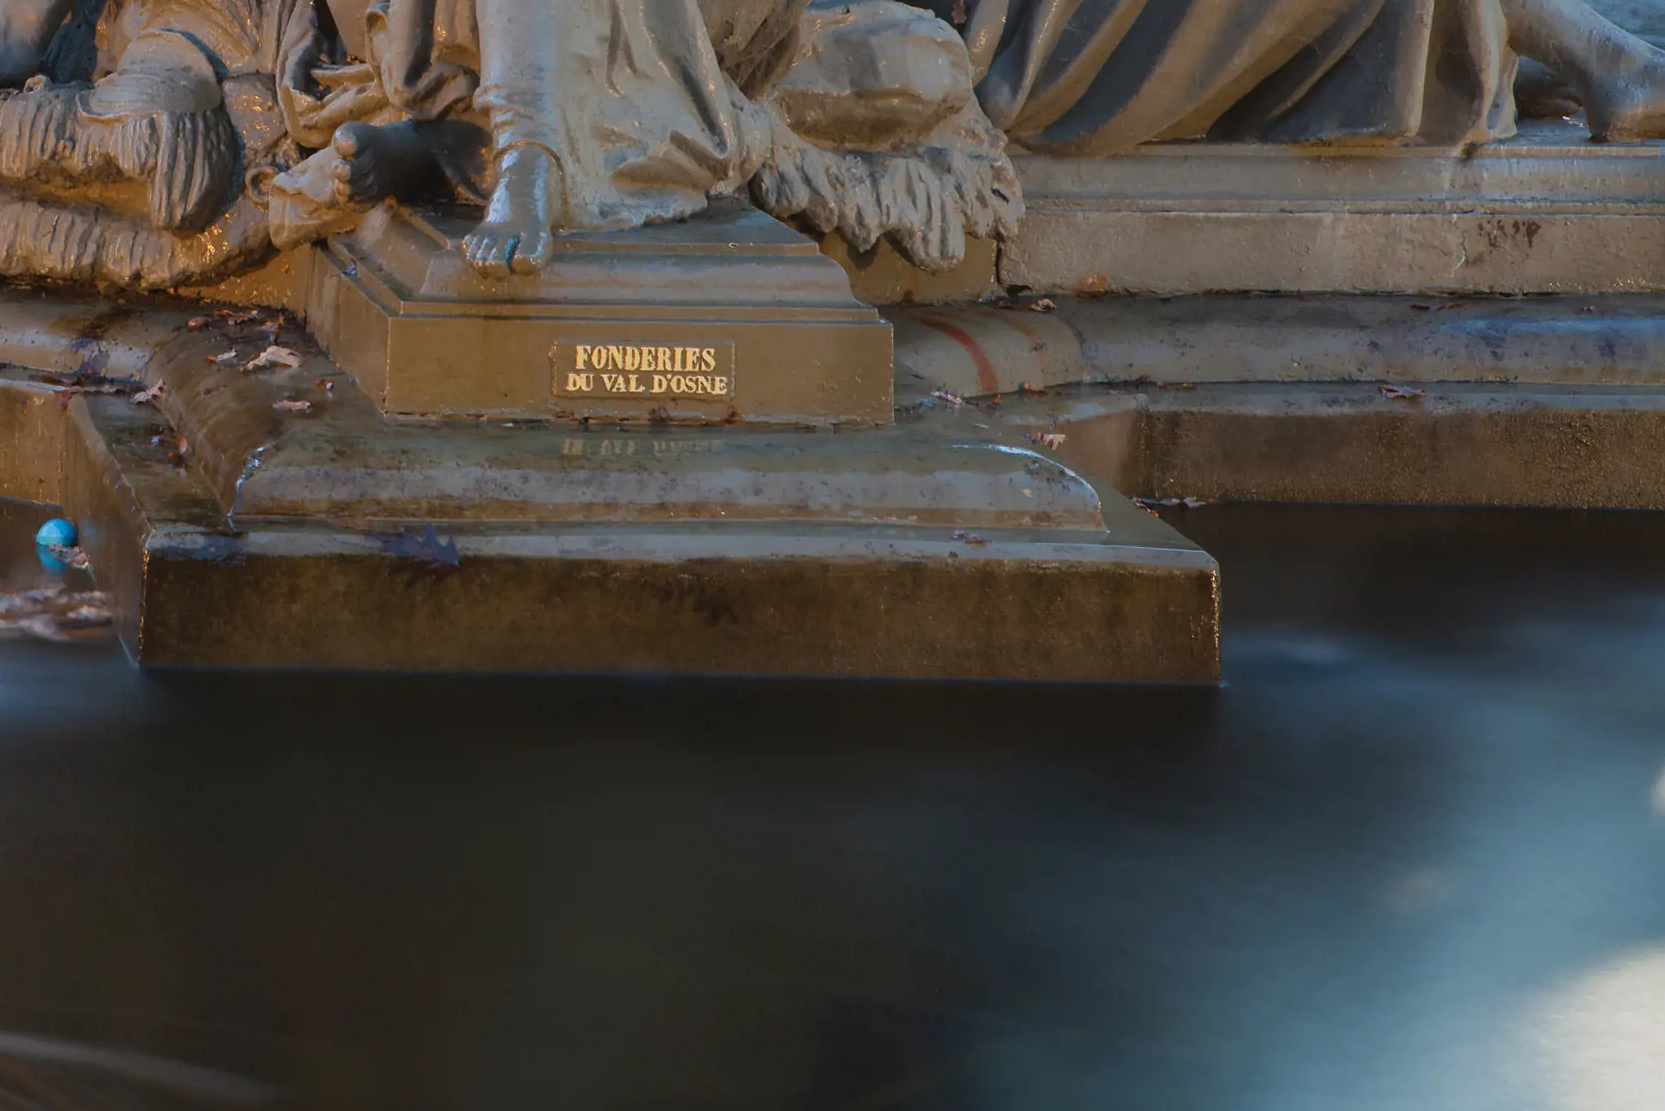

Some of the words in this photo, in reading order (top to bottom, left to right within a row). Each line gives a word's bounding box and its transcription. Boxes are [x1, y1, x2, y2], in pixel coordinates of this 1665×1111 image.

[575, 345, 716, 372] FONDERIES
[565, 372, 594, 392] DU
[649, 373, 728, 396] D'OSNE
